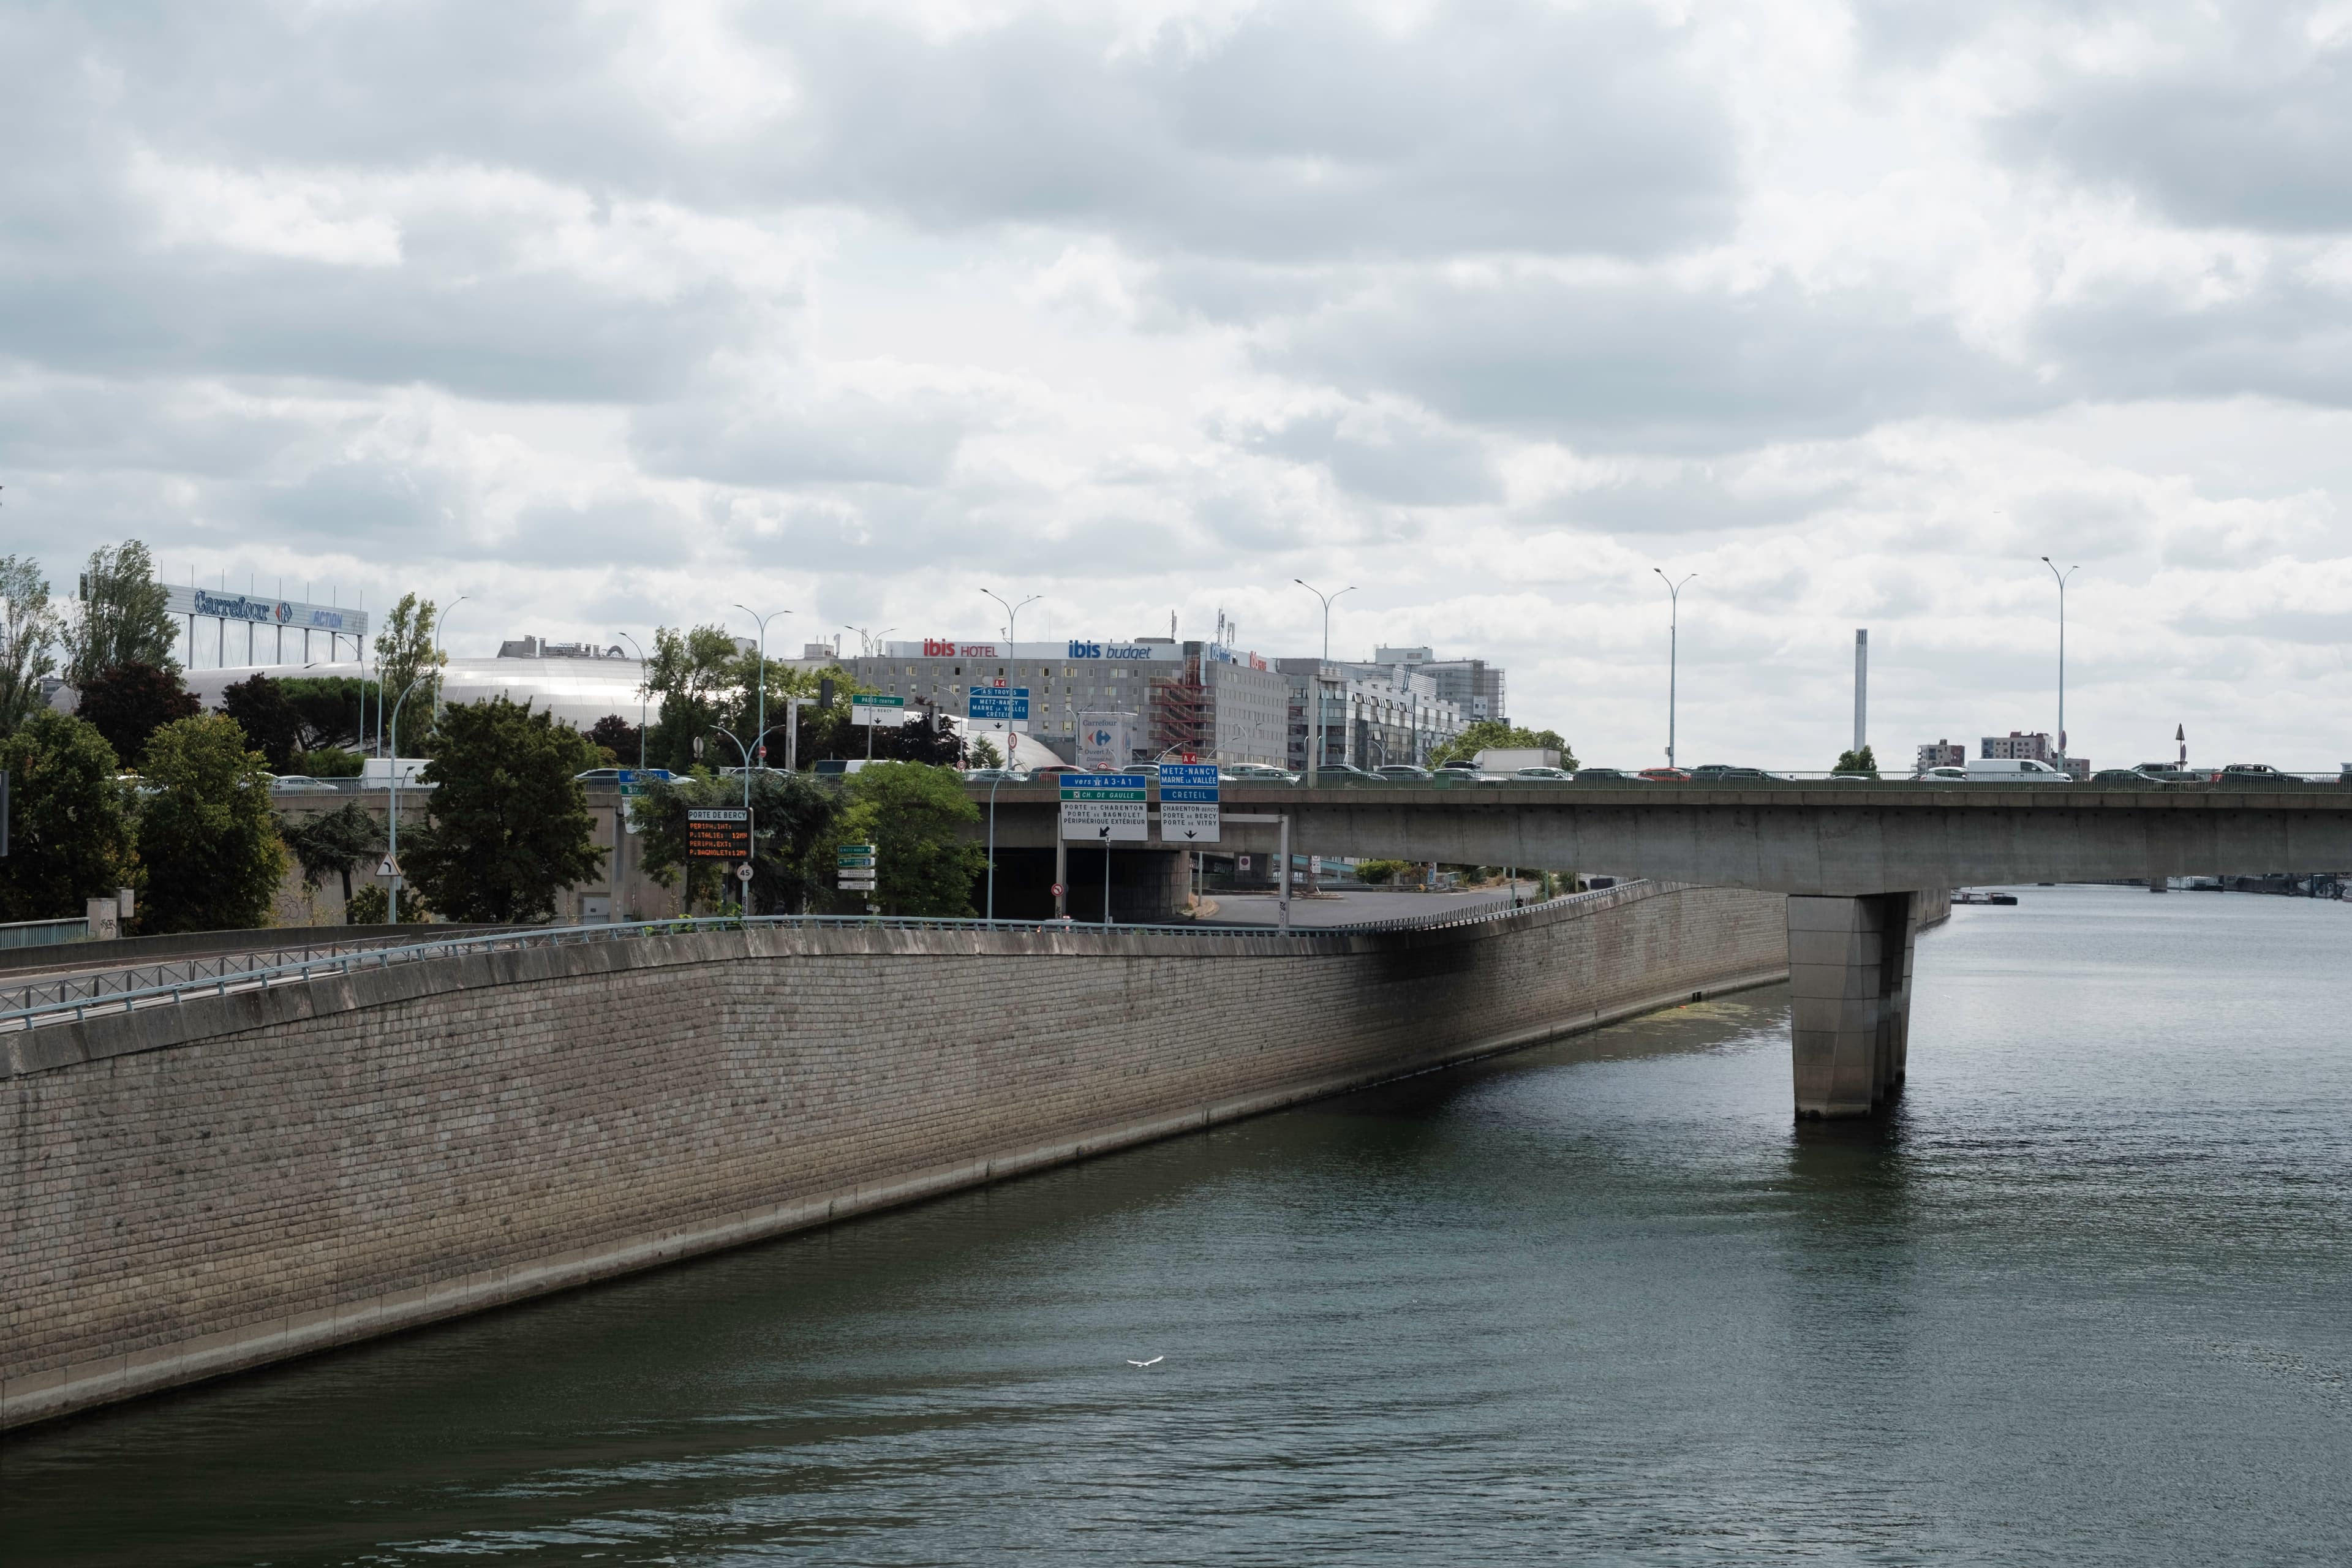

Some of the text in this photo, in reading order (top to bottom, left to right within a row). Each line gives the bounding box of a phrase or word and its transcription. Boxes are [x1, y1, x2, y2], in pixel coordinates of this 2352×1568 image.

[195, 590, 270, 622] Carrefour
[313, 610, 343, 628] ACTION
[924, 638, 998, 657] ibis HOTEL
[1069, 640, 1152, 660] ibis budget
[1193, 775, 1216, 784] VALLÉE
